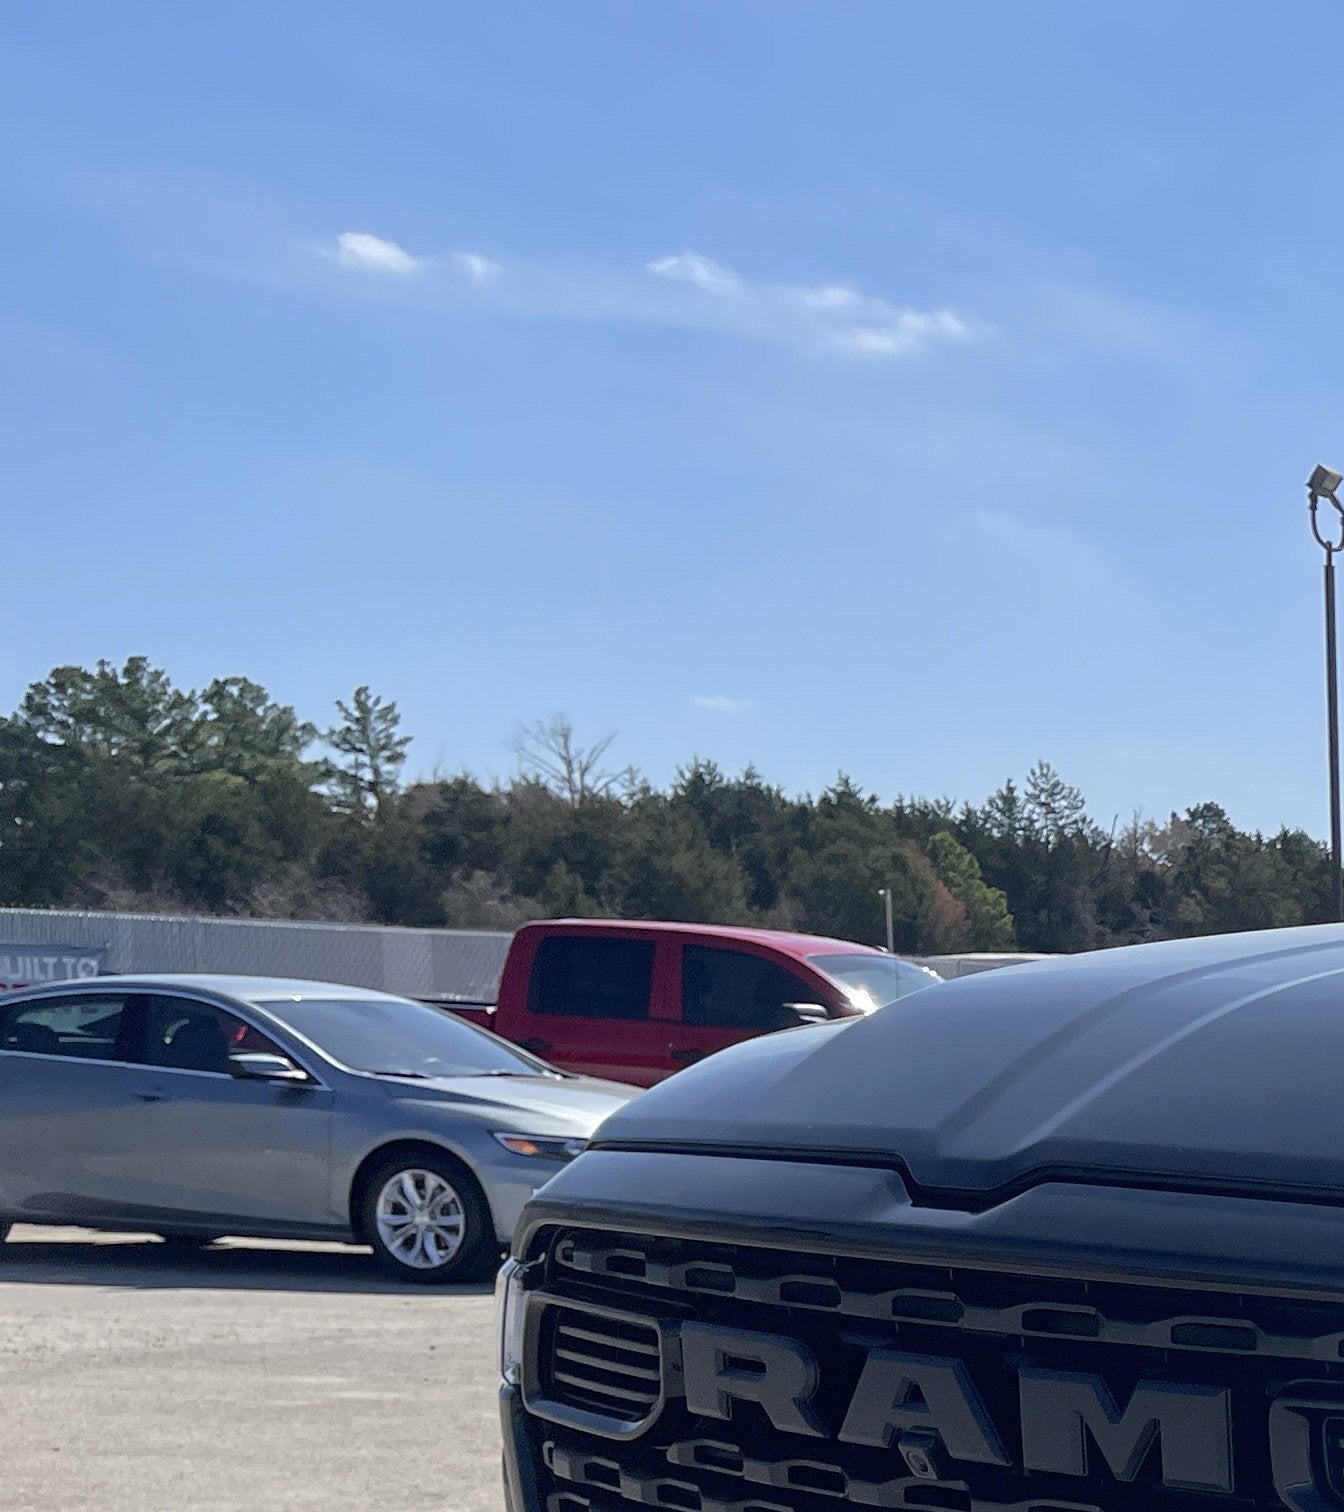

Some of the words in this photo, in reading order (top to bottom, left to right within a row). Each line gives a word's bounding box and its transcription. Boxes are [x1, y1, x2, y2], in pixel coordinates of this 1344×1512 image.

[0, 956, 58, 980] UILT
[61, 957, 98, 979] TO
[681, 1320, 1235, 1492] RAM
